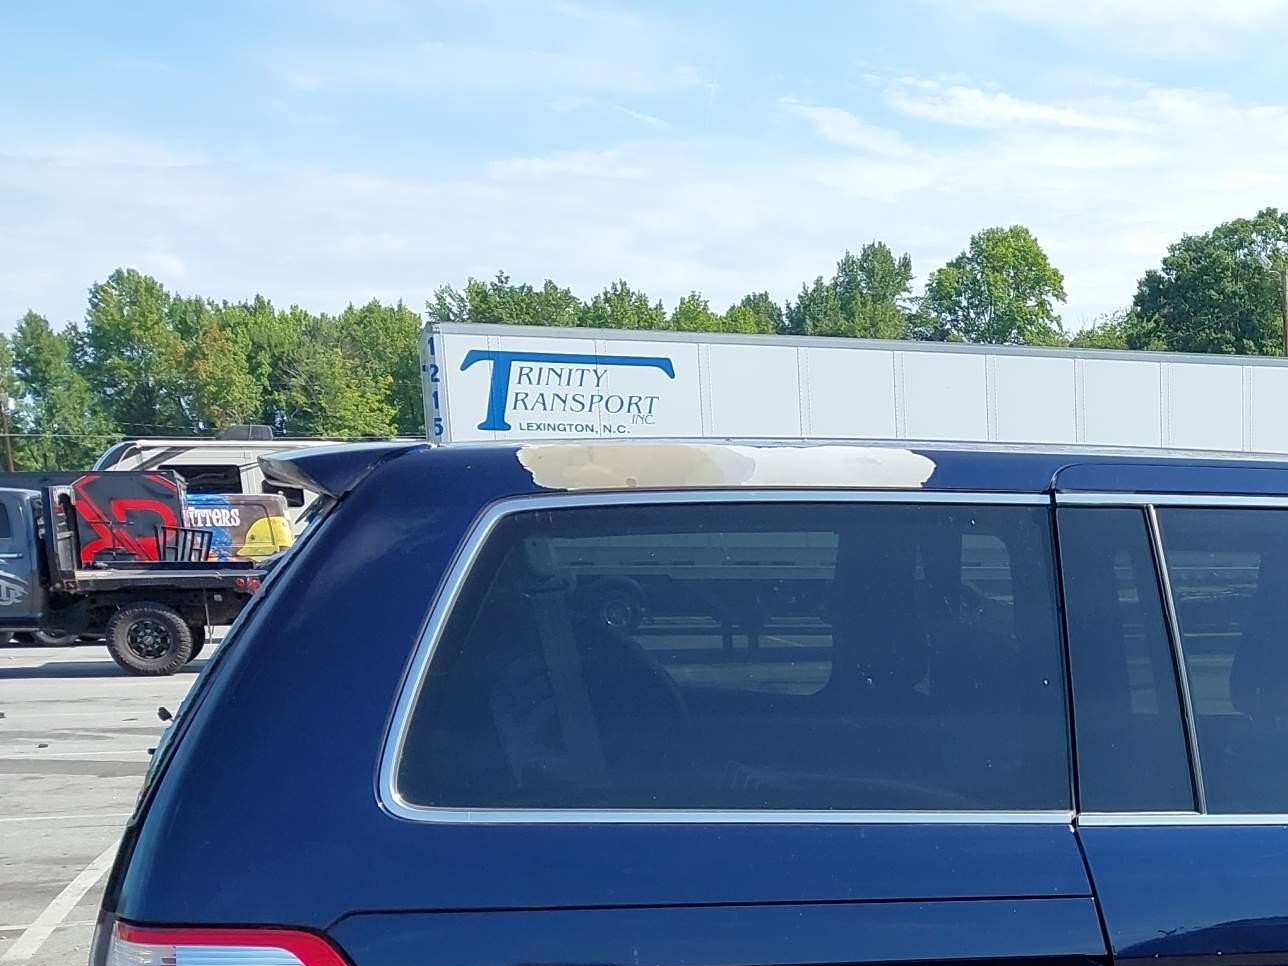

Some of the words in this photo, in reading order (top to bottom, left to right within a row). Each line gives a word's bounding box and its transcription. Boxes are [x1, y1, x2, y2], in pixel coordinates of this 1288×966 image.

[427, 335, 445, 436] 1215
[519, 422, 599, 435] LEXINGTON,
[602, 424, 631, 434] N.C.
